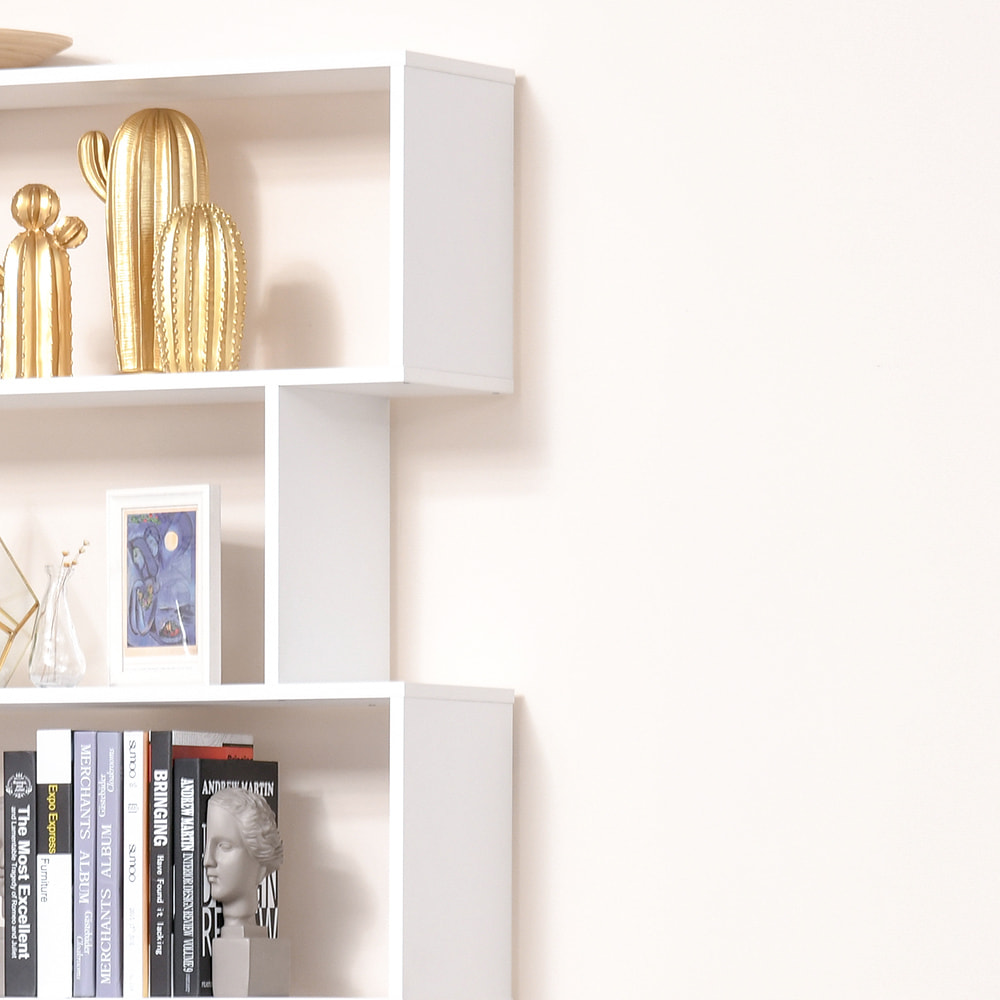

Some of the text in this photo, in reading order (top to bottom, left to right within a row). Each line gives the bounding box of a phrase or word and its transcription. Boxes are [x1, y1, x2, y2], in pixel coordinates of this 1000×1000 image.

[47, 784, 58, 854] Expo Express
[79, 744, 91, 904] MERCHANTS ALBUM
[153, 770, 168, 847] BRINGING
[181, 777, 194, 817] ANDREW
[181, 817, 194, 852] MARTIN
[18, 804, 31, 959] The Most Excellent
[41, 858, 49, 902] Furniture
[100, 824, 112, 984] MERCHANTS ALBUM
[155, 922, 164, 955] lacking
[157, 908, 164, 918] it
